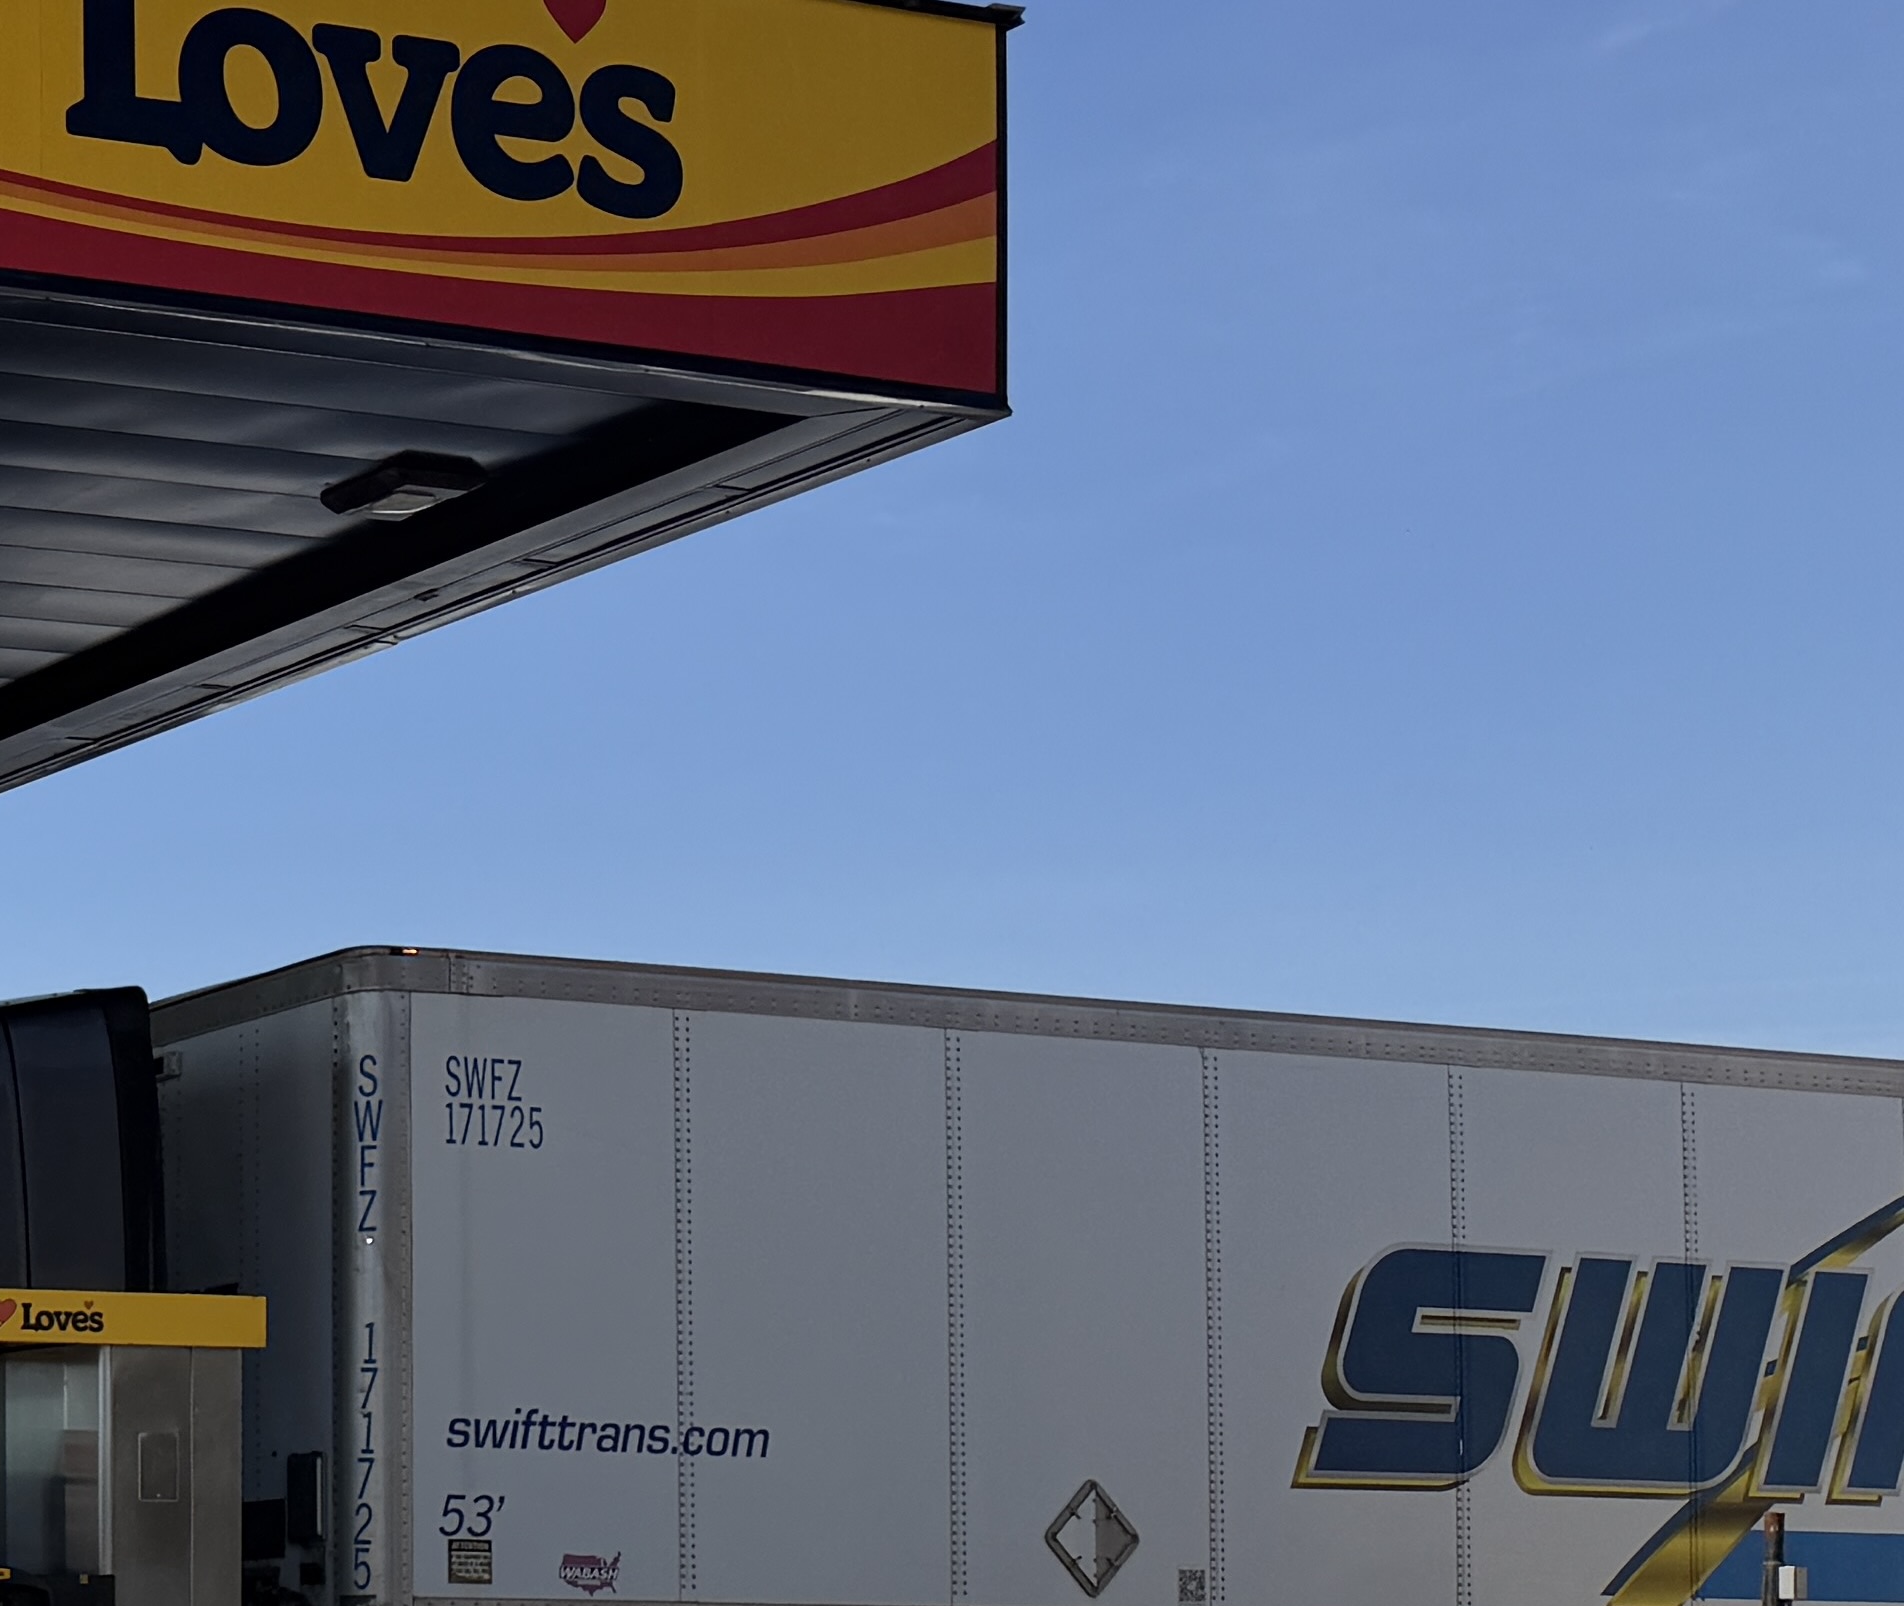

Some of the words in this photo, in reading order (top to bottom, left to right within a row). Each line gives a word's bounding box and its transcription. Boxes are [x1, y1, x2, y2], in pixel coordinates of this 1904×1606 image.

[445, 1055, 522, 1101] SWFZ
[353, 1055, 383, 1233] SWFZ
[445, 1102, 543, 1149] 171725
[446, 1407, 770, 1458] swifttrans.com
[352, 1322, 378, 1591] 171725
[439, 1494, 504, 1537] 53'
[559, 1566, 619, 1580] WABASH
